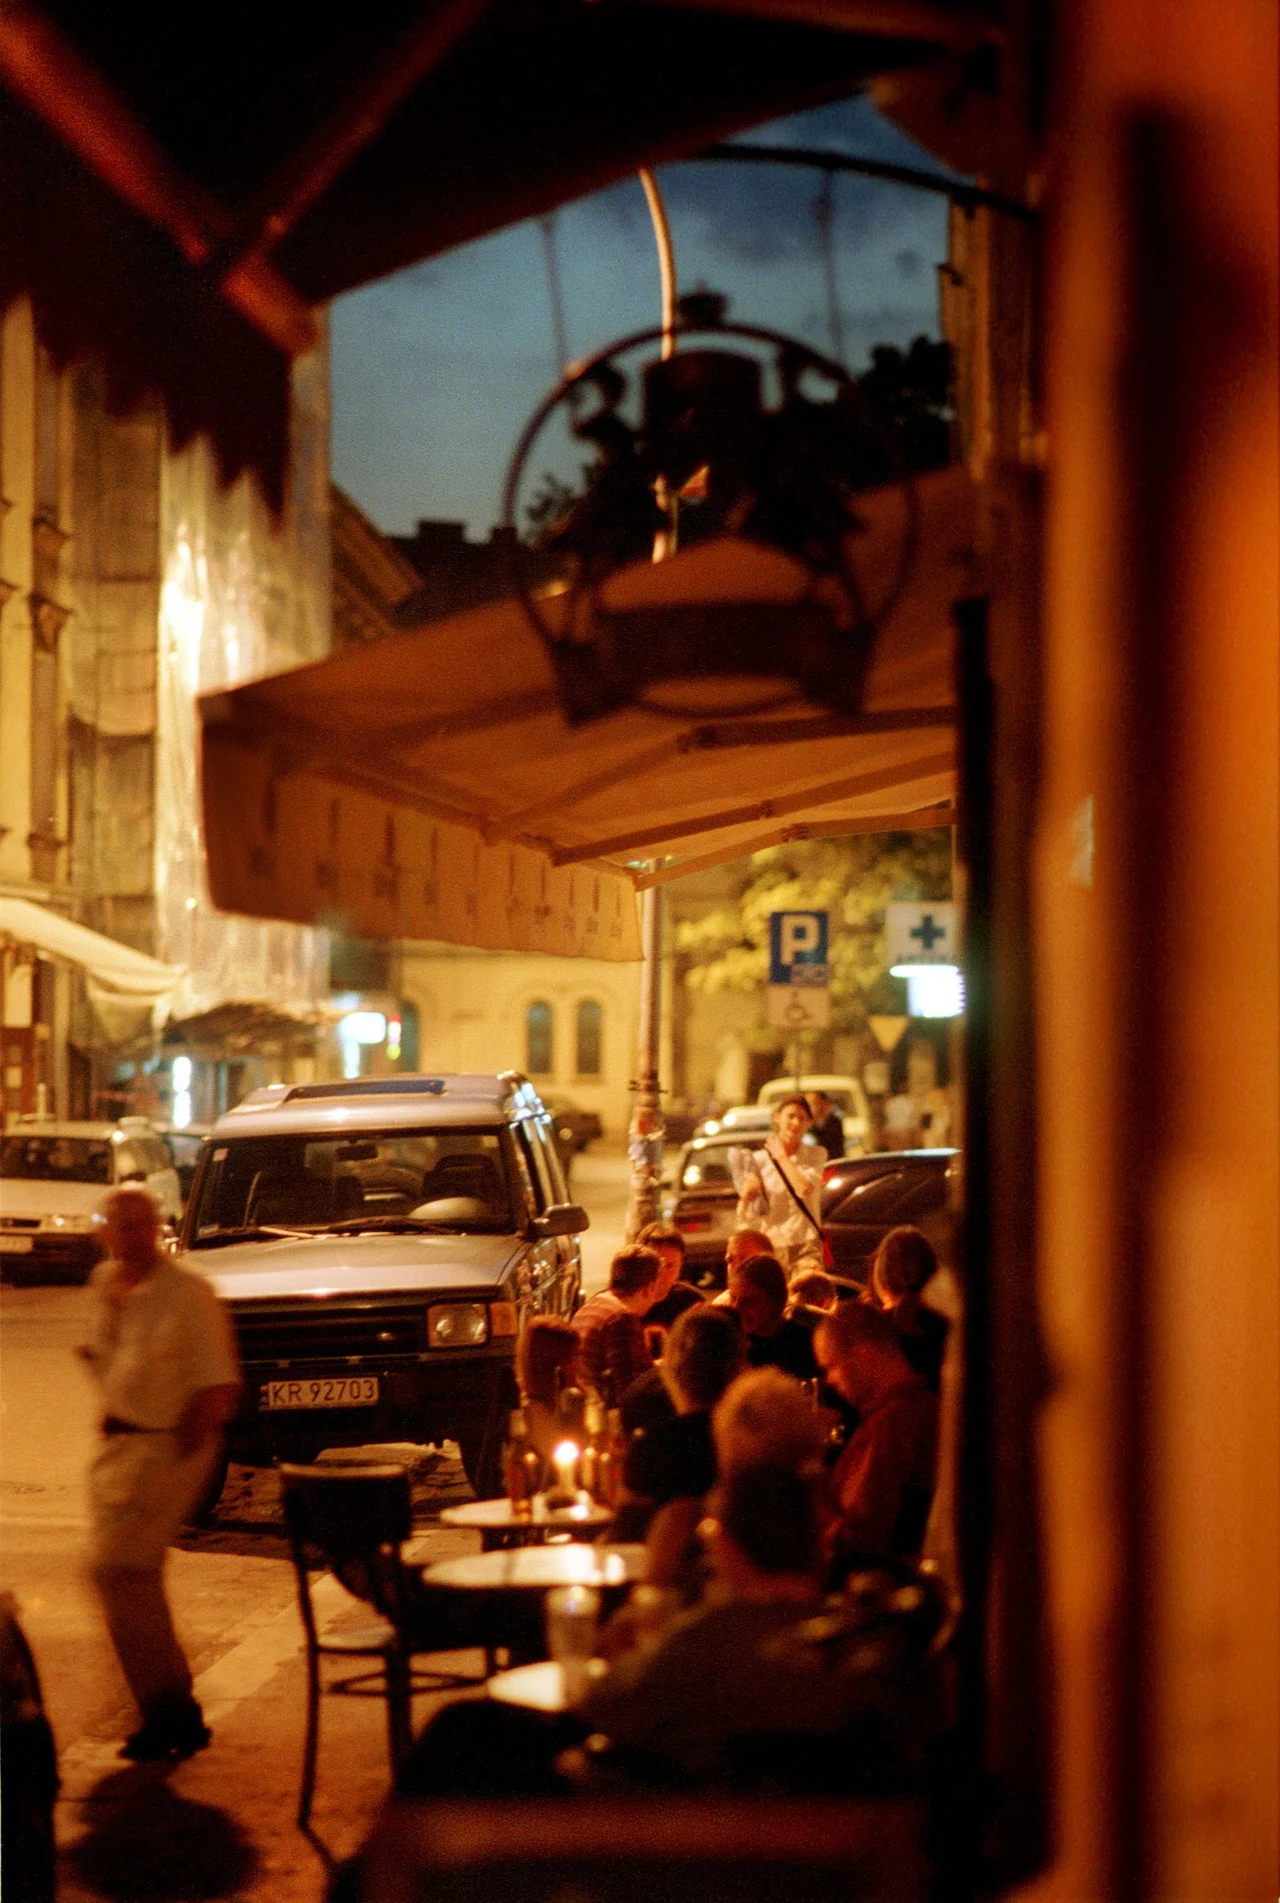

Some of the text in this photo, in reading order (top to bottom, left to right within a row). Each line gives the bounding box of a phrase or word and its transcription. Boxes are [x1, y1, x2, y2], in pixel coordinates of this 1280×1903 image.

[780, 914, 820, 966] P
[272, 1380, 374, 1404] KR 92703
